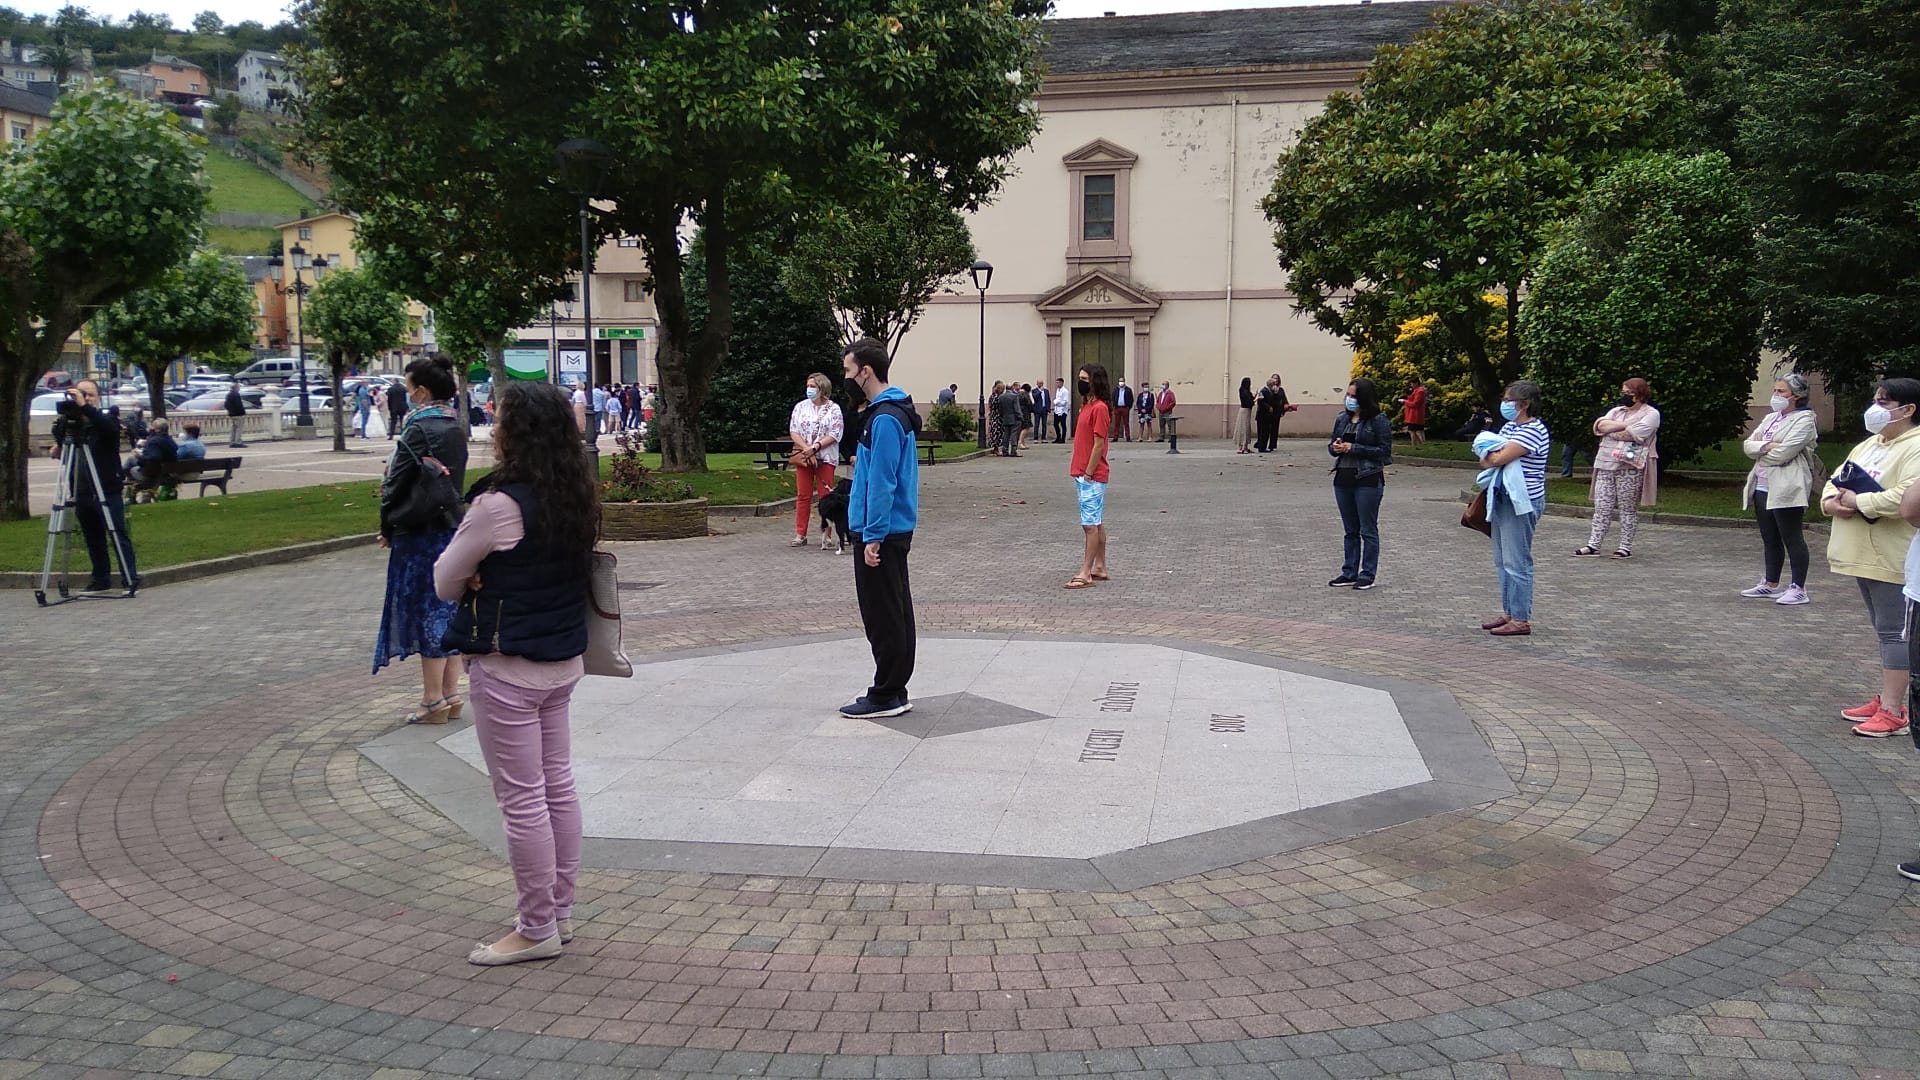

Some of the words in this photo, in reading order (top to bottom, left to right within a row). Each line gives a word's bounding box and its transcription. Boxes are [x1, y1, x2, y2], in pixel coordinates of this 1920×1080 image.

[1092, 681, 1140, 712] PARQUE
[1209, 713, 1246, 733] 2003
[1078, 728, 1125, 763] MEDAL
